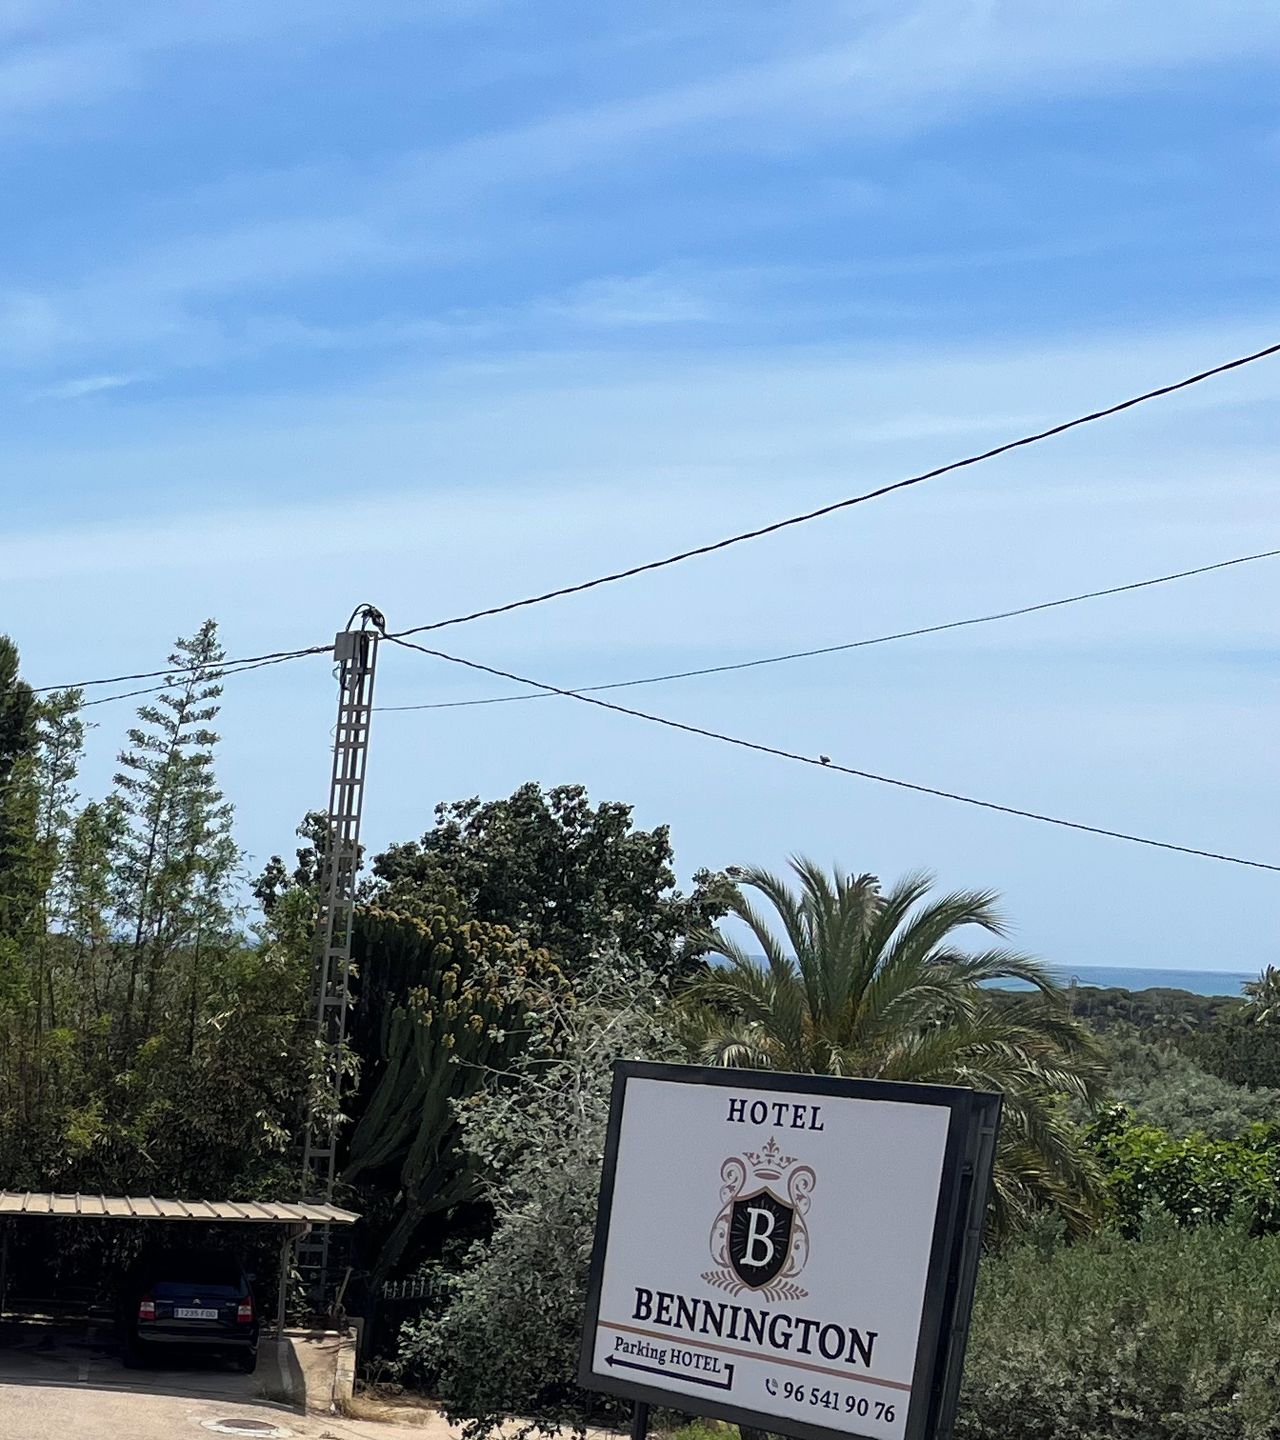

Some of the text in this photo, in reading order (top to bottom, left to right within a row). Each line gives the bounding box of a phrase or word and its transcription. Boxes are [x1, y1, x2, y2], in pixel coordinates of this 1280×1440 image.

[726, 1097, 825, 1132] HOTEL
[739, 1206, 776, 1268] B
[631, 1287, 879, 1369] BENNINGTON
[613, 1336, 722, 1374] Parking HOTEL
[782, 1381, 896, 1423] 96 541 90 76
